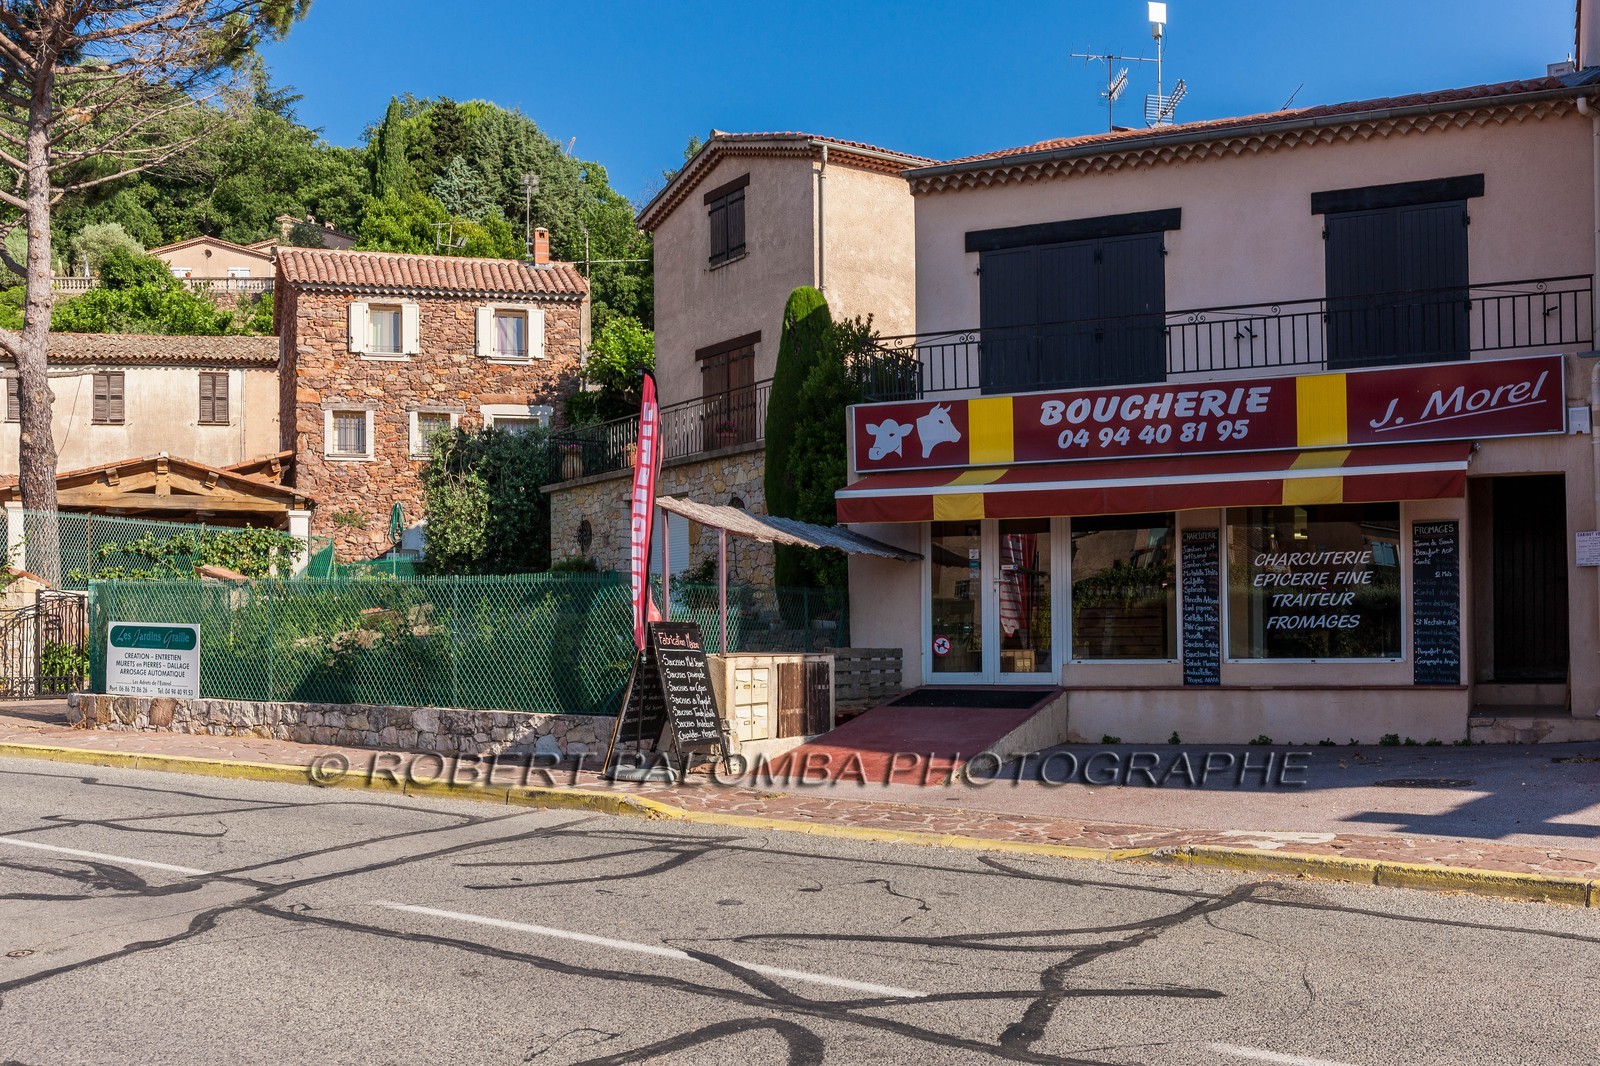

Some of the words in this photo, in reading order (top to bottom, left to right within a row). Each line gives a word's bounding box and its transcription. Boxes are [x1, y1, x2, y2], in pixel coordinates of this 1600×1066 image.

[1040, 386, 1272, 426] BOUCHERIE
[1369, 398, 1404, 428] J.
[1420, 370, 1548, 420] Morel
[1058, 428, 1090, 448] 04
[1099, 426, 1130, 448] 94
[1138, 424, 1172, 444] 40
[1180, 422, 1207, 442] 81
[1216, 419, 1250, 442] 95
[1182, 530, 1218, 542] CHARCUTERIE
[1414, 524, 1454, 536] FROMAGES
[1254, 550, 1372, 566] CHARCUTERIE
[1254, 572, 1330, 586] EPICERIE
[1333, 570, 1374, 585] FINE
[1272, 592, 1356, 608] TRAITEUR
[1266, 614, 1360, 630] FROMAGES
[116, 628, 131, 642] Les
[132, 628, 161, 646] Jardins
[163, 630, 190, 648] Graille
[148, 670, 185, 678] AUTOMATIQUE
